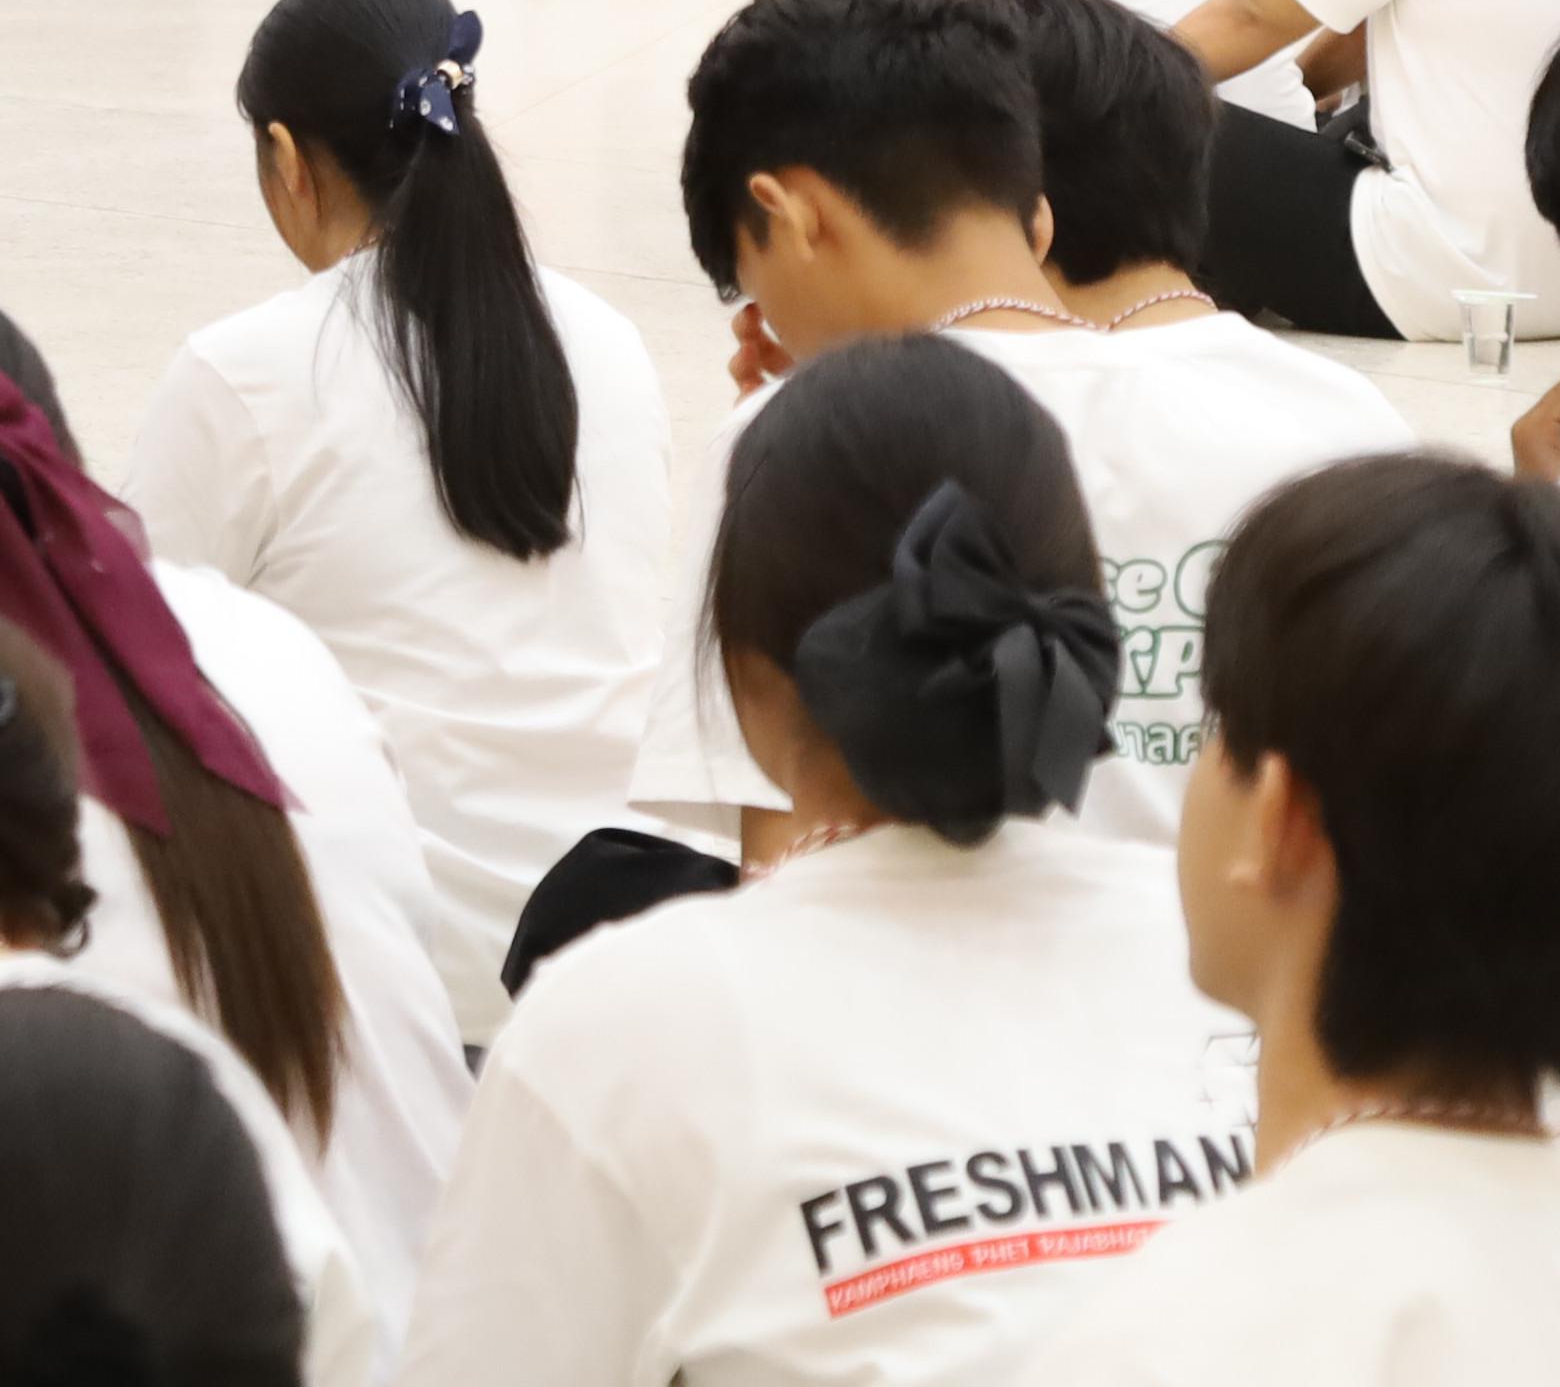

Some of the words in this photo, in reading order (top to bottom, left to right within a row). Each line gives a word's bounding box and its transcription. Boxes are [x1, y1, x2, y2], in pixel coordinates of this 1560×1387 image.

[799, 1134, 1255, 1277] FRESHMAN
[830, 1251, 965, 1309] KAMPHAENG
[973, 1241, 1030, 1266] PHET
